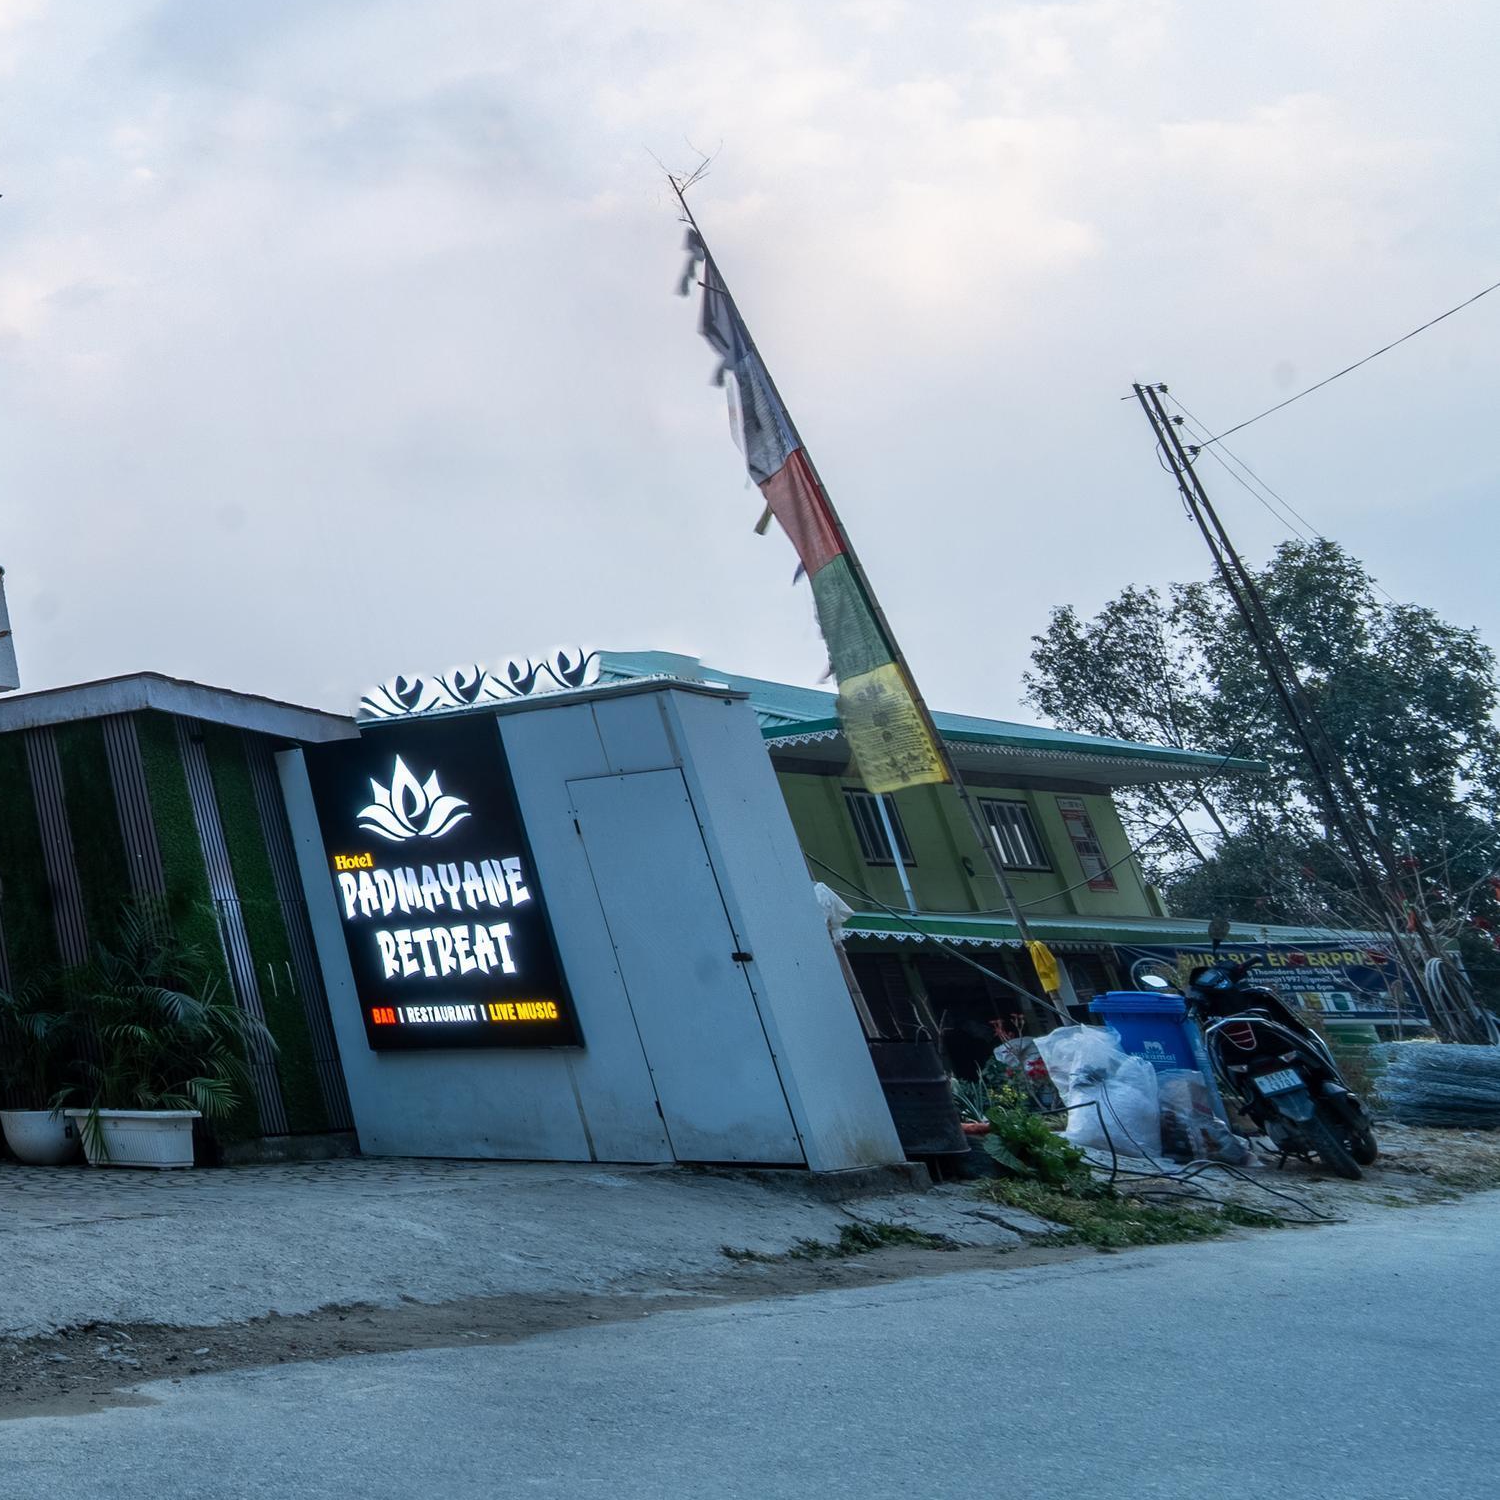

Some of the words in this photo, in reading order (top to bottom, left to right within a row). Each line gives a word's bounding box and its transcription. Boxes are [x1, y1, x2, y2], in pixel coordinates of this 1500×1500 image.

[335, 853, 373, 870] Hotel
[338, 856, 531, 920] PADMAYANE
[375, 922, 518, 980] RETREAT
[1267, 951, 1388, 967] ENERPRIS
[372, 1007, 397, 1024] BAR
[406, 1005, 478, 1024] RESTAURANT
[489, 1003, 518, 1021] LIVE
[518, 1001, 559, 1020] MUSIC
